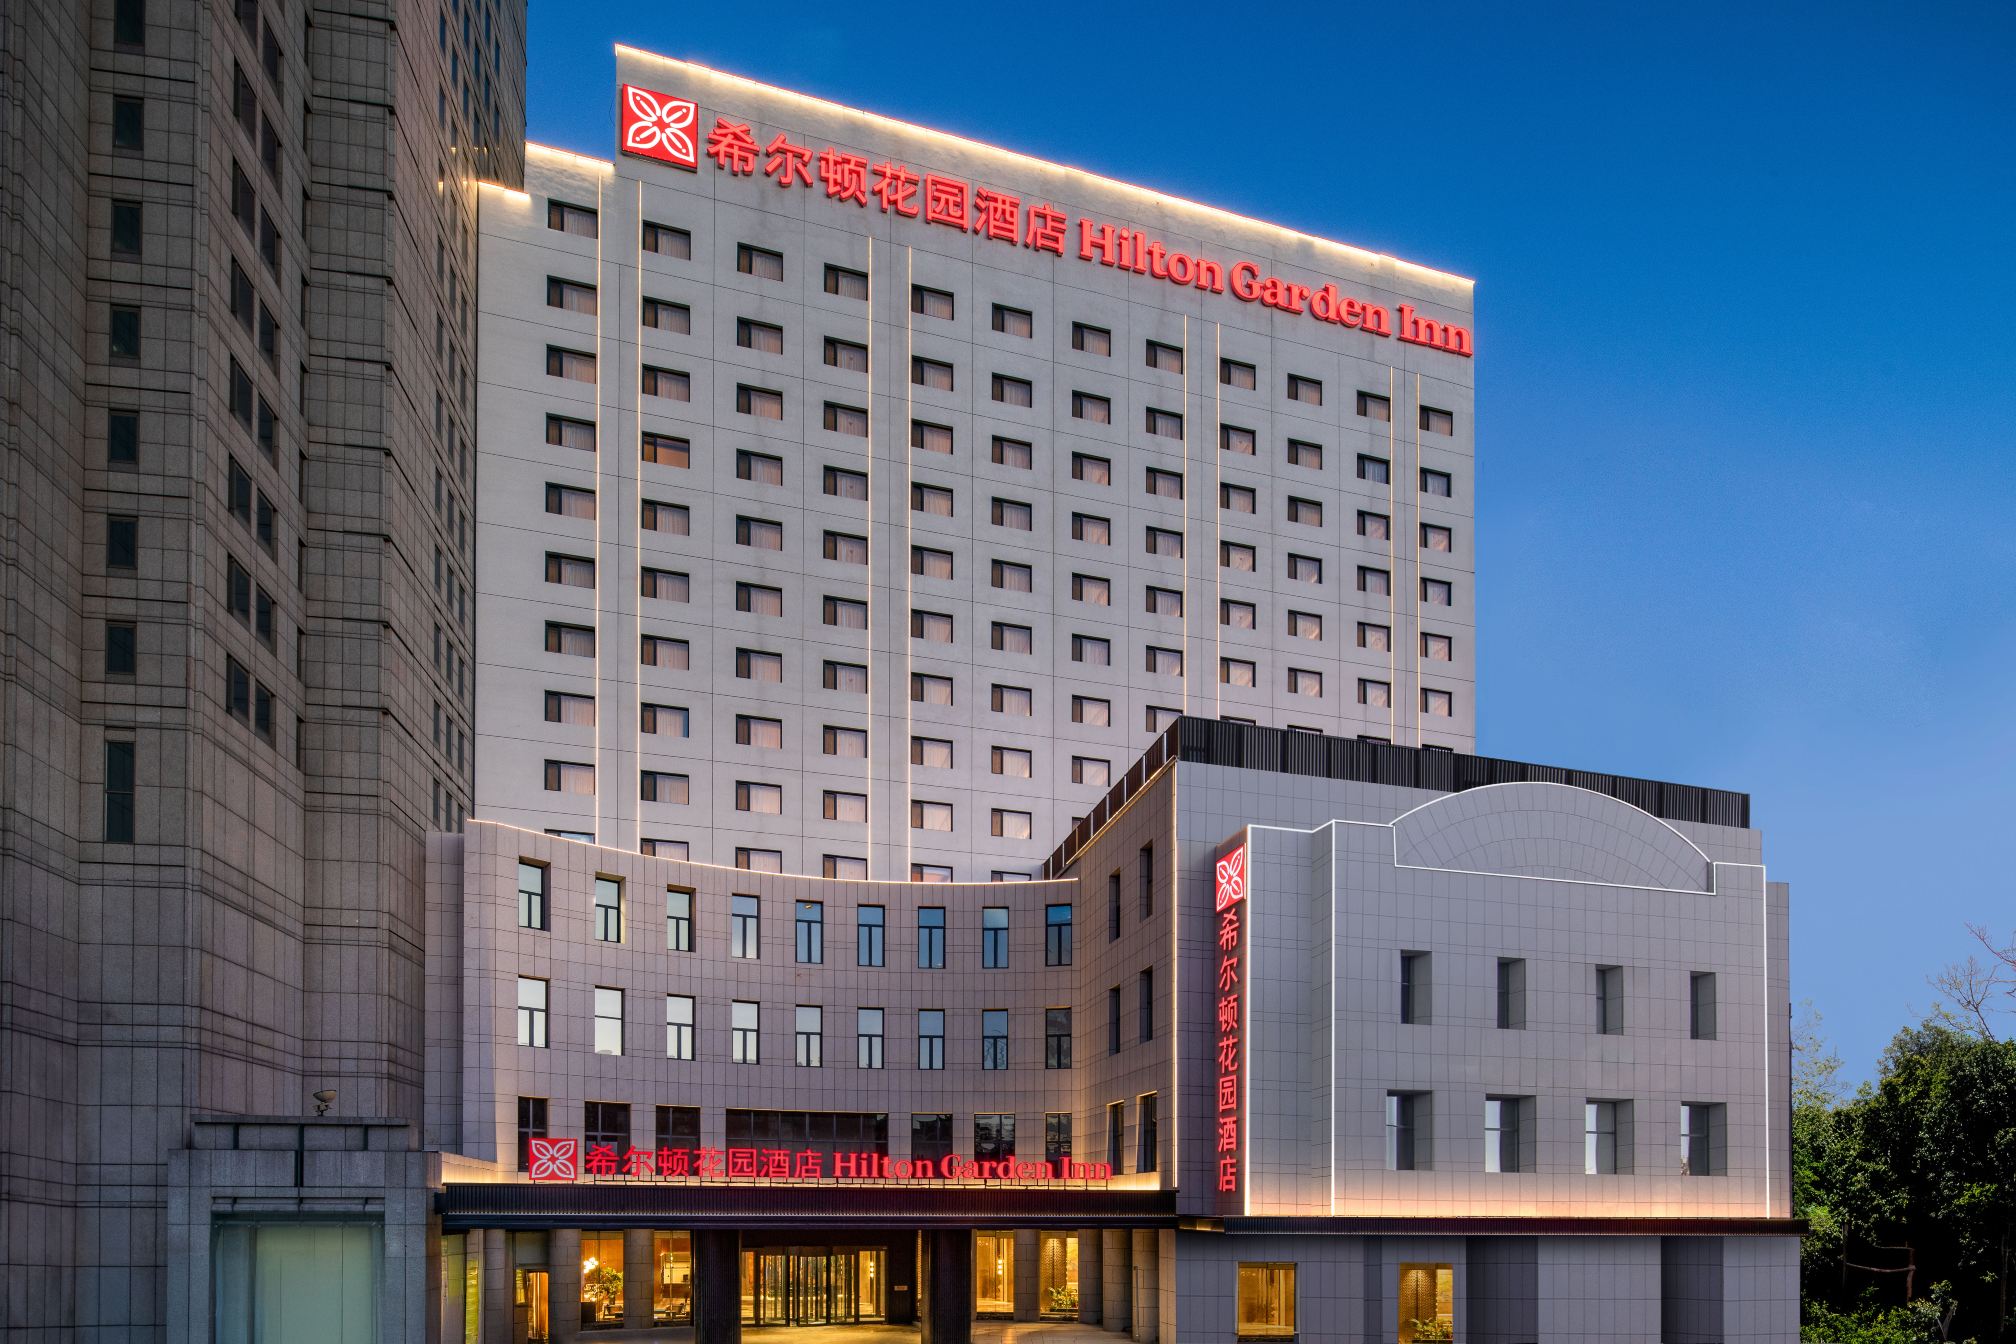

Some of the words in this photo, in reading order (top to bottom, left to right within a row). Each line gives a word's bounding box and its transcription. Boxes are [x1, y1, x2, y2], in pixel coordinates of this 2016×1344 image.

[707, 118, 1067, 256] 希尔顿花园酒店
[1079, 217, 1224, 293] Hilton
[1231, 261, 1391, 337] Garden
[1398, 303, 1472, 357] Inn
[585, 1144, 822, 1178] 希尔顿花园酒店
[833, 1152, 934, 1179] Hilton
[940, 1154, 1054, 1180] Garden
[1059, 1156, 1112, 1180] Inn
[1218, 908, 1239, 1191] 希尔顿花园酒店
